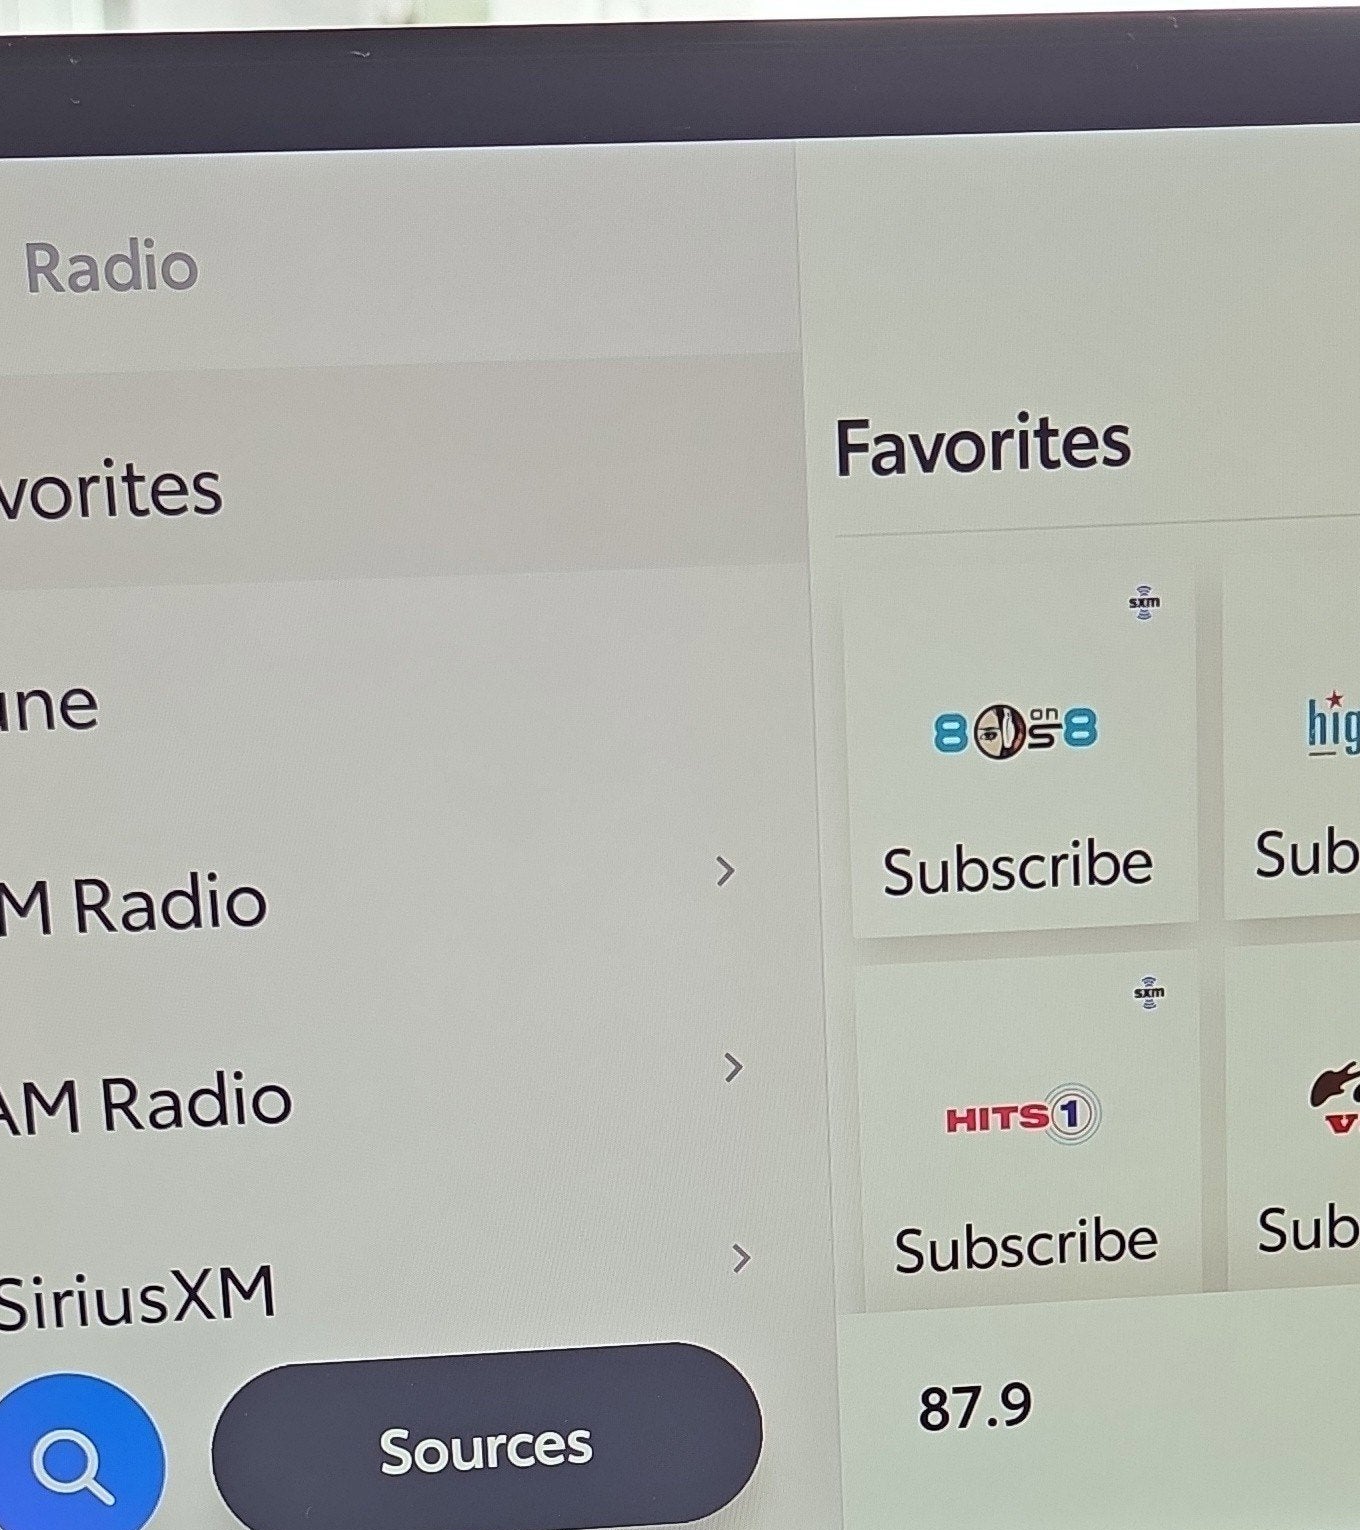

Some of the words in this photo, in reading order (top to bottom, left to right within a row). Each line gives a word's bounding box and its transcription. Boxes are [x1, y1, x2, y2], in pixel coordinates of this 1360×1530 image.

[25, 236, 199, 294] Radio
[837, 411, 1131, 477] Favorites
[1128, 595, 1160, 609] sxm
[1029, 706, 1059, 722] on
[884, 837, 1153, 897] Subscribe
[74, 871, 267, 934] Radio
[1134, 986, 1165, 998] sxm
[102, 1070, 292, 1132] Radio
[946, 1103, 1051, 1133] HITS
[896, 1215, 1158, 1274] Subscribe
[919, 1381, 1032, 1432] 87.9
[380, 1428, 593, 1475] Sources
